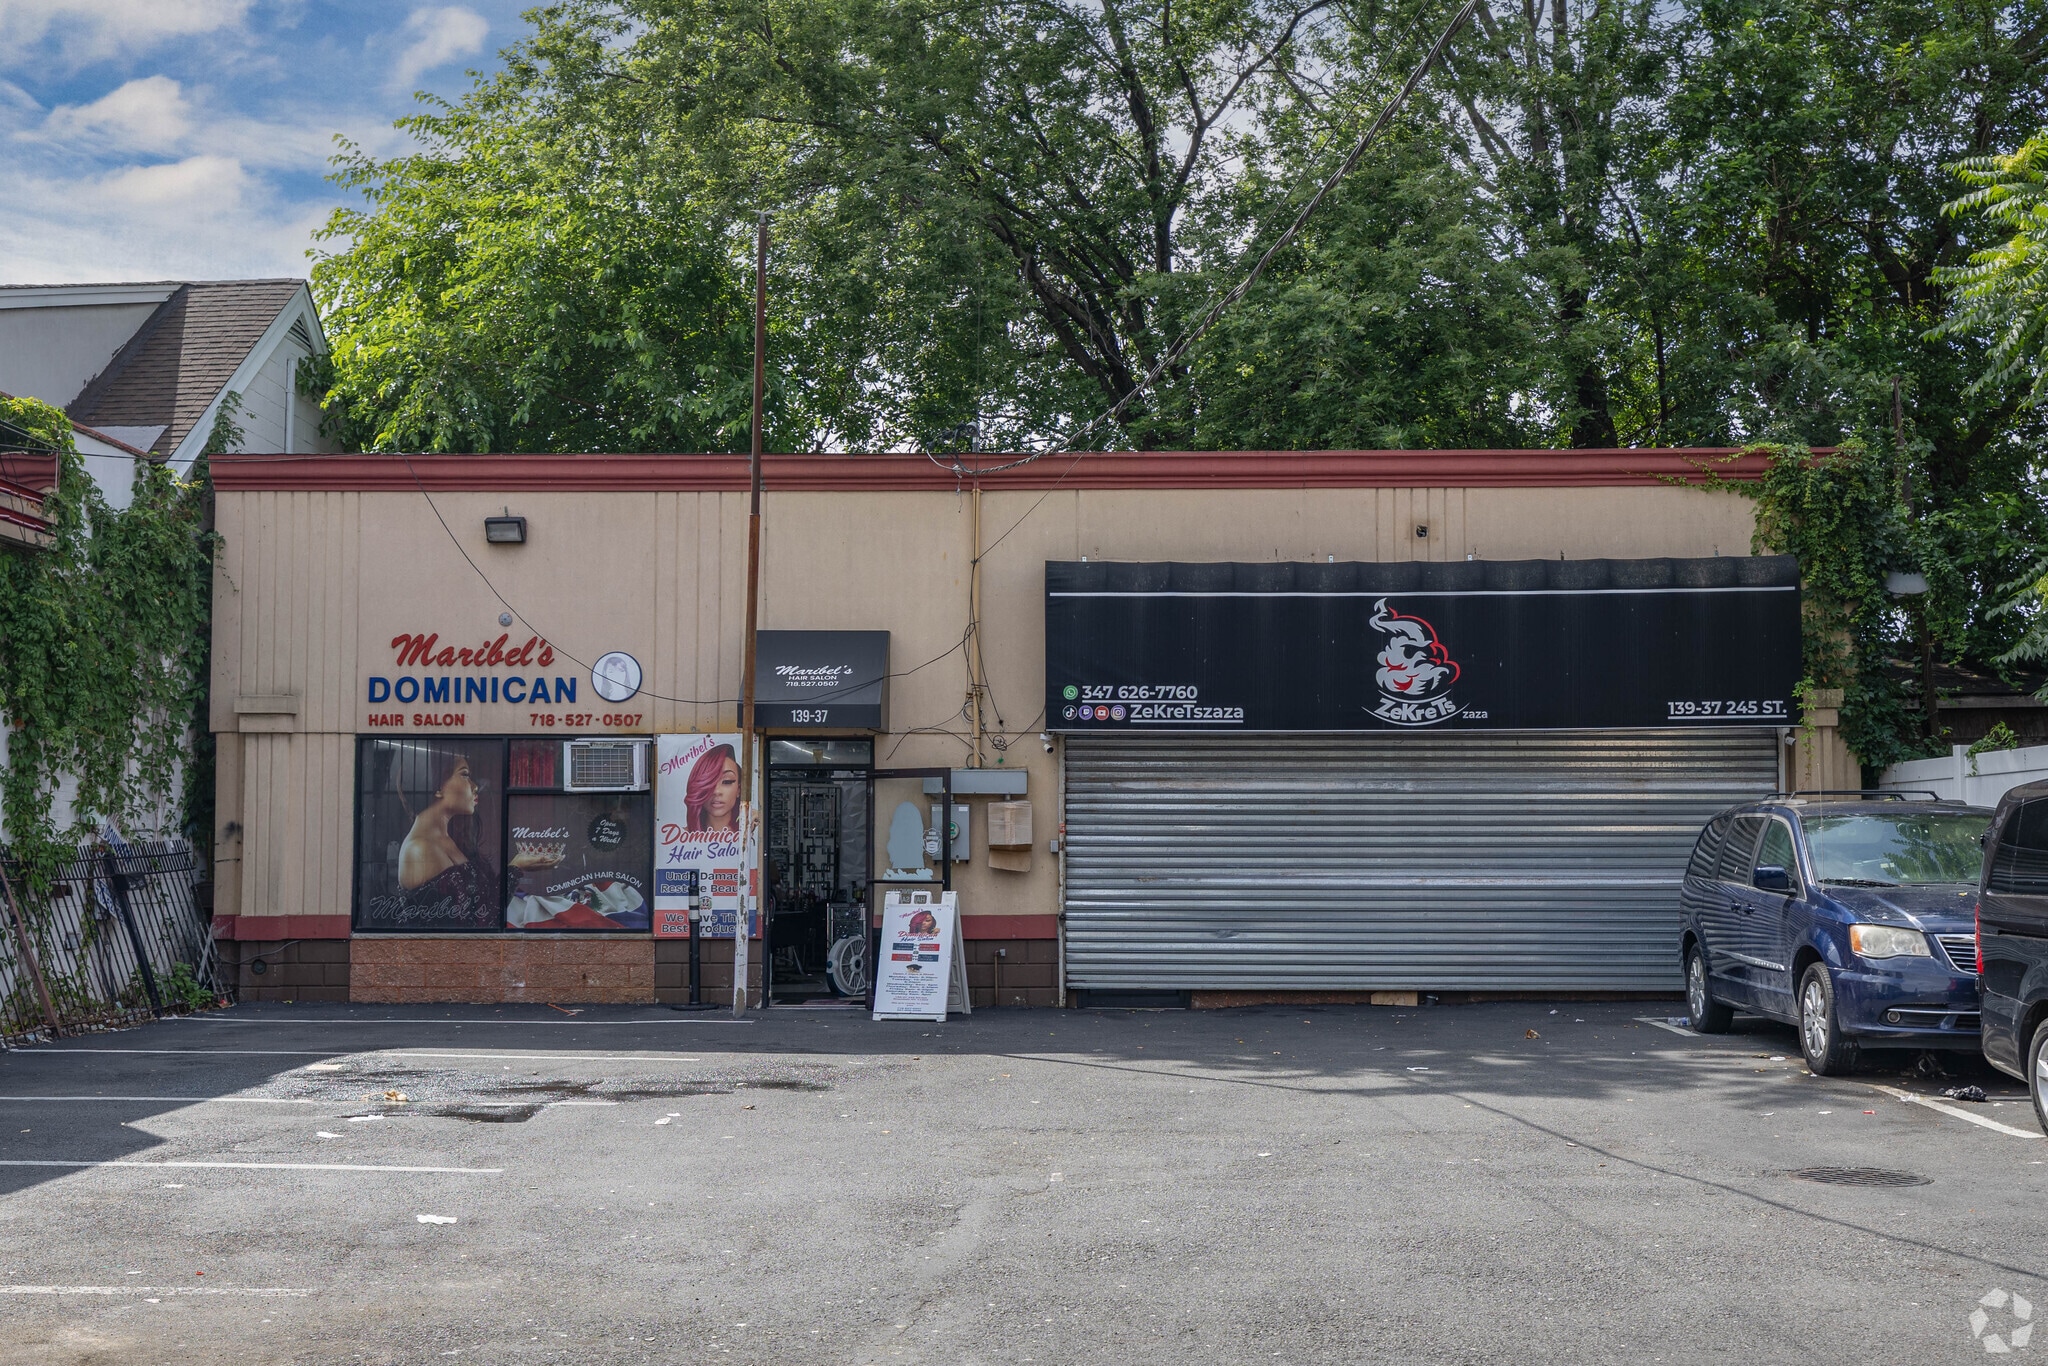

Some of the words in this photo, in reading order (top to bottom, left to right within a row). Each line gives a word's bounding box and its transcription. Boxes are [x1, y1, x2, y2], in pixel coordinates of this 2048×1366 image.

[391, 633, 555, 667] Maribel's
[775, 664, 853, 676] Maribel's
[368, 676, 577, 703] DOMINICAN
[1082, 685, 1113, 699] 347
[1118, 685, 1198, 699] 626-7760
[1130, 704, 1244, 719] ZeKreTszaza
[1374, 697, 1457, 722] ZeKreTs
[1462, 710, 1488, 719] zaza
[1668, 701, 1722, 715] 139-37
[1726, 700, 1758, 714] 245
[1762, 700, 1787, 714] ST.
[368, 714, 404, 726] HAIR
[413, 714, 465, 726] SALON
[791, 709, 828, 723] 139-37
[660, 736, 716, 776] Maribel's
[600, 819, 617, 828] Open
[512, 827, 570, 839] Maribel's
[661, 823, 740, 846] Dominica
[666, 845, 702, 865] Hair
[707, 842, 740, 860] Salo
[546, 873, 593, 894] DOMINICAN
[594, 871, 614, 879] HAIR
[615, 871, 643, 889] SALON
[700, 872, 739, 882] Damag
[661, 884, 707, 893] Reste
[711, 884, 752, 893] Beau
[369, 895, 489, 920] Maribel's
[666, 913, 684, 922] We
[721, 913, 736, 923] Th
[662, 924, 688, 933] Best
[700, 924, 738, 933] roduc
